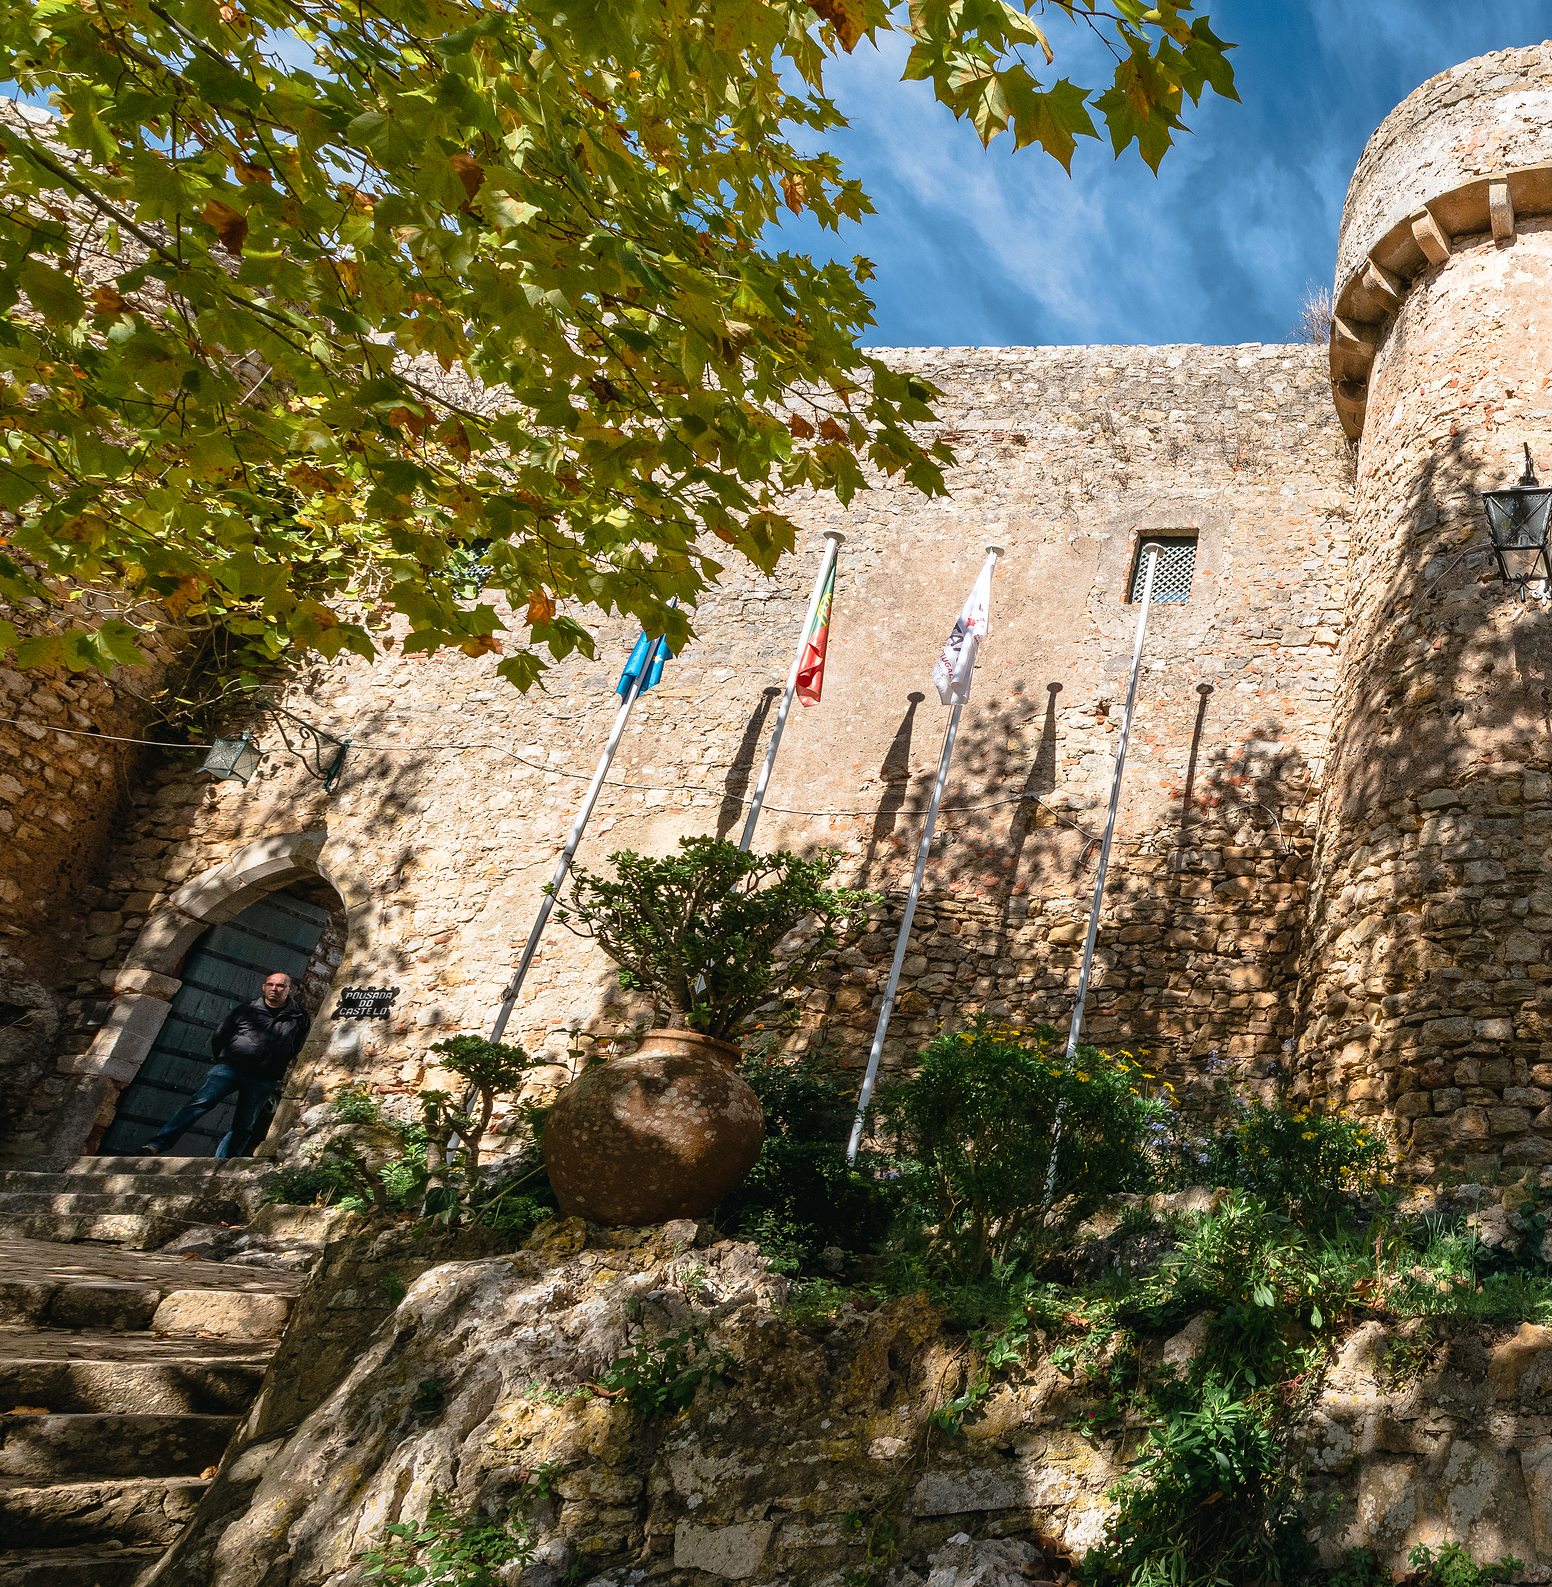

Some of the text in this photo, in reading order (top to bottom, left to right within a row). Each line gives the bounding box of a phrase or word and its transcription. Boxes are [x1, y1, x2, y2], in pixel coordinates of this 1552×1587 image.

[345, 991, 393, 1000] POUSADA
[358, 999, 374, 1007] DO
[339, 1007, 388, 1015] CASTELO
